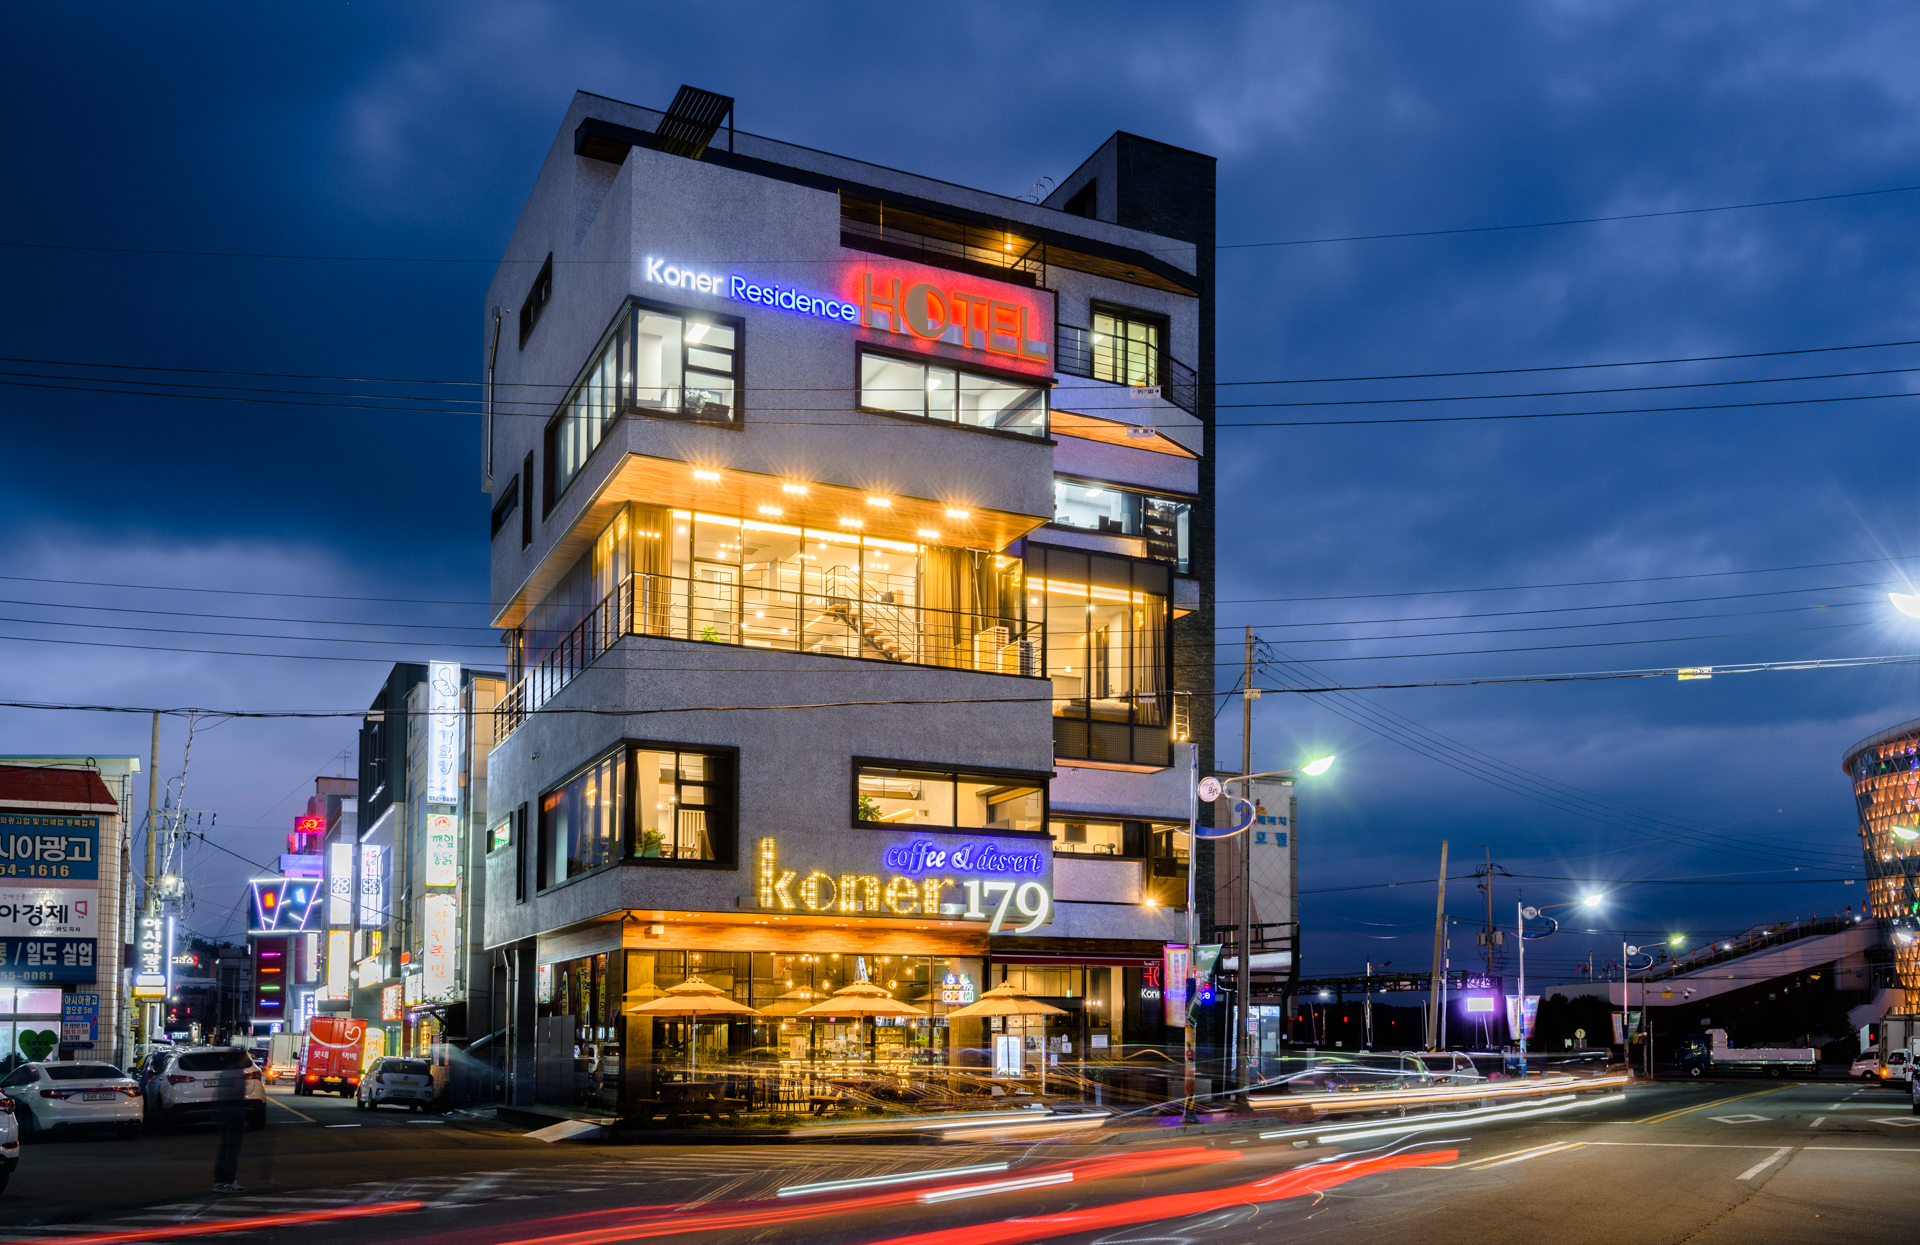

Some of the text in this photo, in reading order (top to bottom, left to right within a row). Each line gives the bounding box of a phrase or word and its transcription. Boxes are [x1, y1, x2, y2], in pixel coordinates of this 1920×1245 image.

[646, 257, 1049, 363] Koner Residence HOTEL
[32, 817, 40, 826] 및
[42, 818, 64, 827] 인쇄업
[1257, 815, 1287, 826] 해비치
[1255, 831, 1288, 847] 모텔
[887, 841, 1042, 874] coffee & dessert
[759, 836, 1050, 934] koner 179
[0, 904, 68, 926] 아경제
[26, 941, 57, 966] 일도
[62, 942, 93, 967] 실업
[142, 918, 162, 975] 아시아광고
[64, 995, 98, 1006] 아시아광고
[944, 991, 973, 1001] OPEN
[313, 1050, 357, 1060] 롯데 택배
